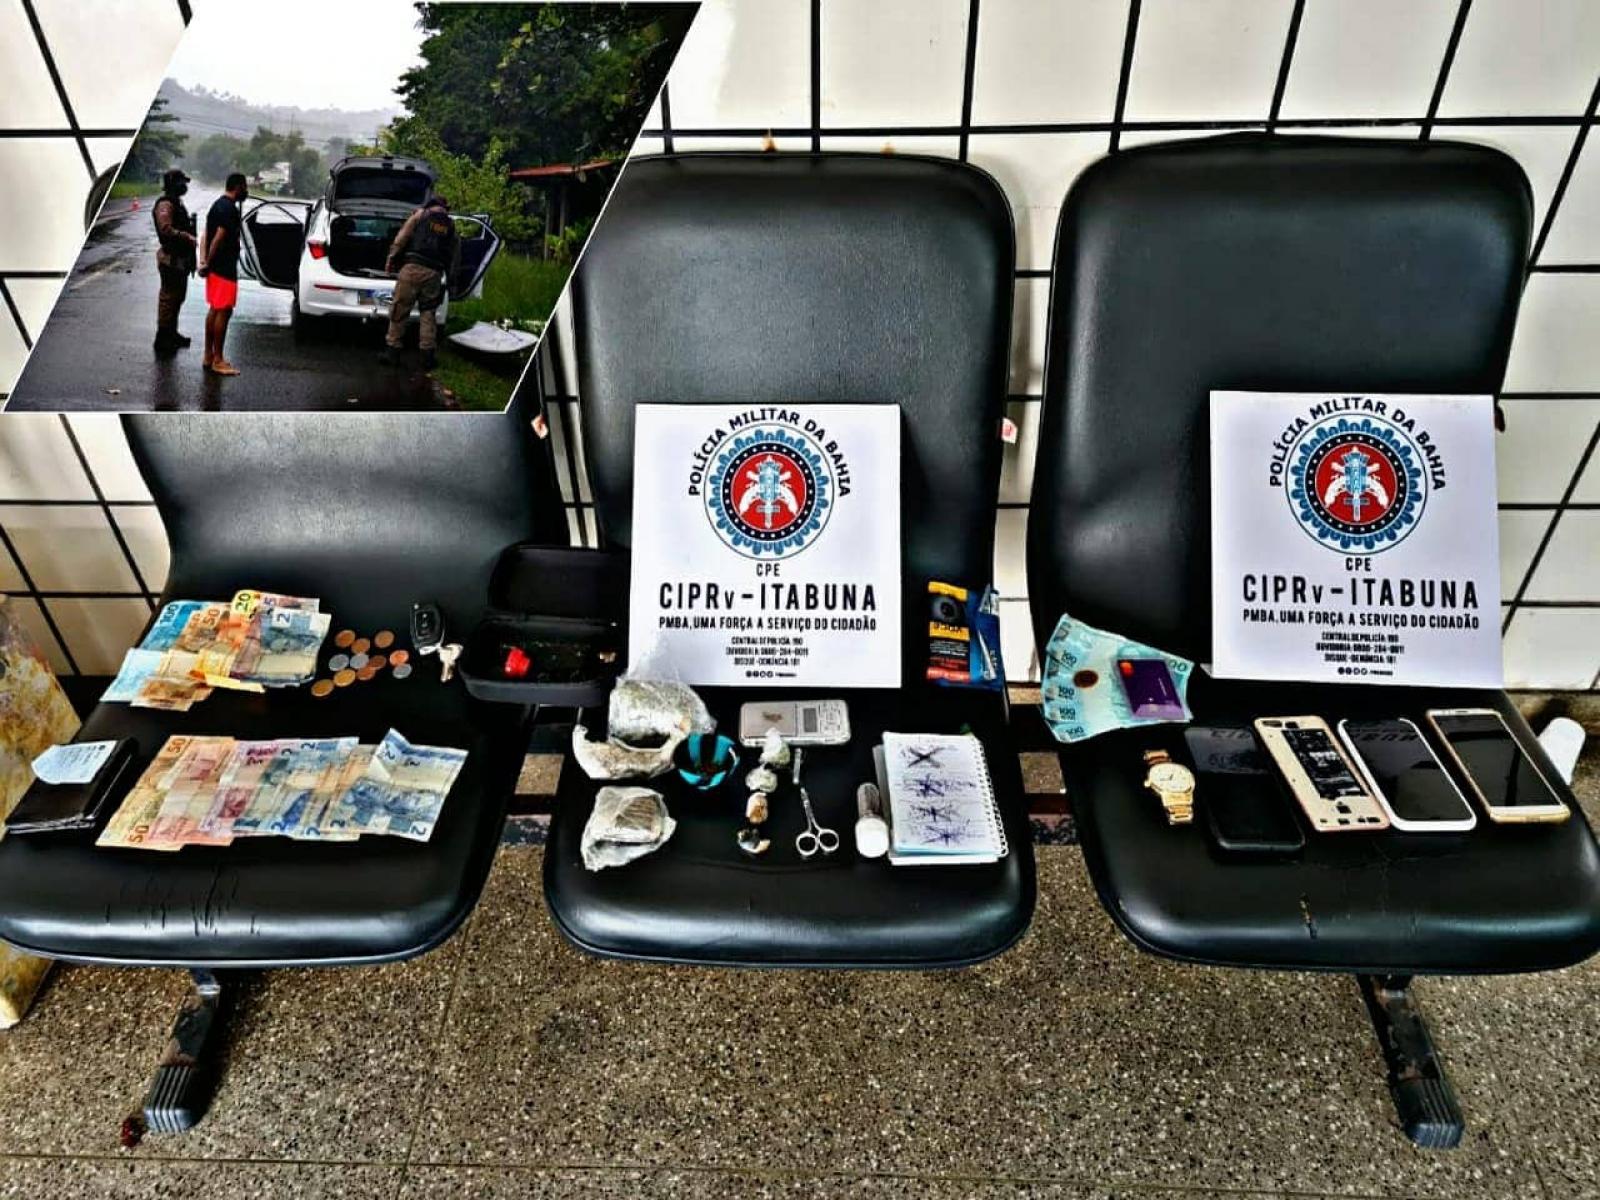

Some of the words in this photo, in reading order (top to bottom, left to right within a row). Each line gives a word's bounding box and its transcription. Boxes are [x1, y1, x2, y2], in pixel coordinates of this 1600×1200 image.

[688, 428, 727, 496] POLÍCIA
[729, 408, 800, 430] MILITAR
[804, 419, 825, 442] DA
[825, 441, 851, 497] BAHIA
[1269, 417, 1309, 487] POLÍCIA
[1309, 397, 1387, 420] MILITAR
[1392, 409, 1415, 433] DA
[1416, 431, 1446, 490] BAHIA
[756, 563, 780, 576] CPE
[1345, 557, 1371, 571] CPE
[719, 616, 753, 631] FORÇA
[757, 617, 764, 629] A
[767, 616, 811, 632] SERVIÇO
[815, 617, 828, 630] DO
[831, 615, 876, 631] CIDADÃO
[1308, 611, 1344, 627] FORÇA
[1348, 613, 1355, 626] A
[1359, 613, 1407, 630] SERVIÇO
[1411, 614, 1425, 628] DO
[1429, 613, 1479, 630] CIDADÃO
